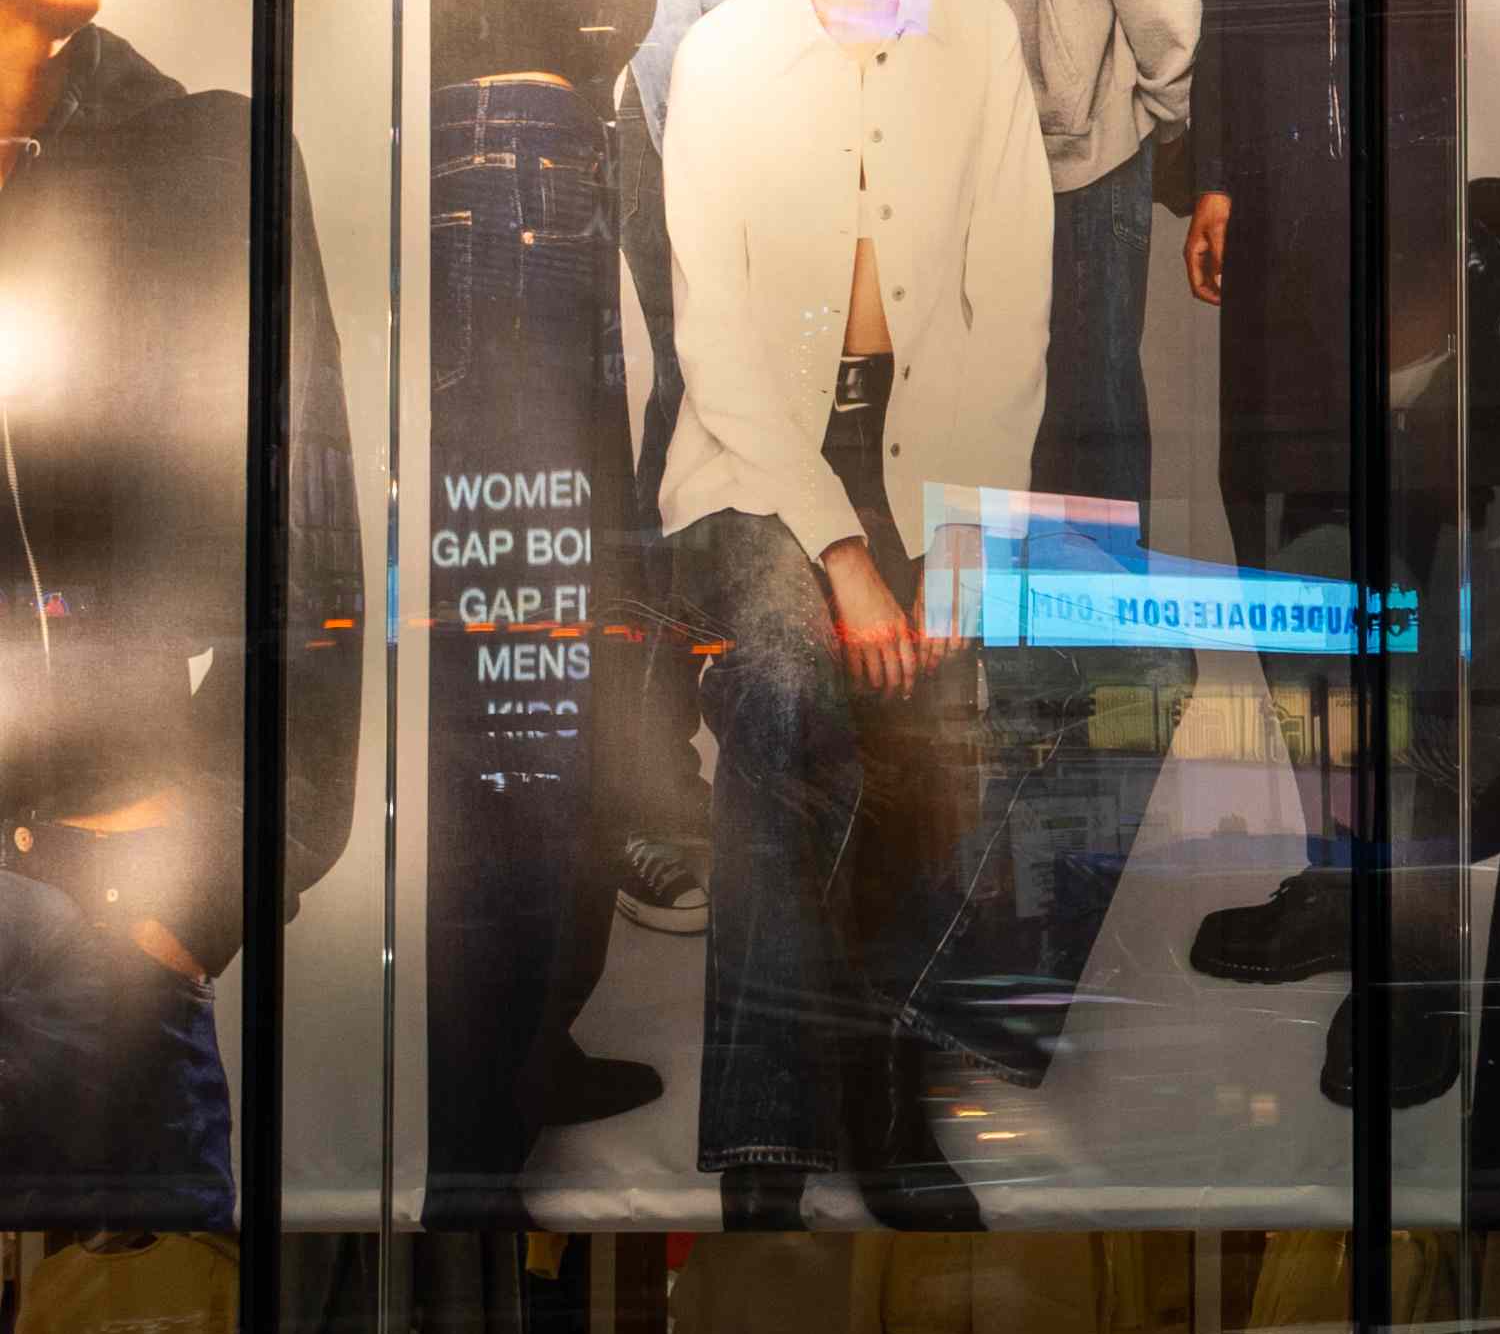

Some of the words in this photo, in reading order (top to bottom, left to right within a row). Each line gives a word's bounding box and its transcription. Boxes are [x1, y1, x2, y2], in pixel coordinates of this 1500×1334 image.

[431, 528, 514, 567] GAP
[527, 526, 592, 565] BO
[459, 586, 542, 624] GAP
[554, 583, 591, 623] FI
[477, 642, 591, 683] MENS
